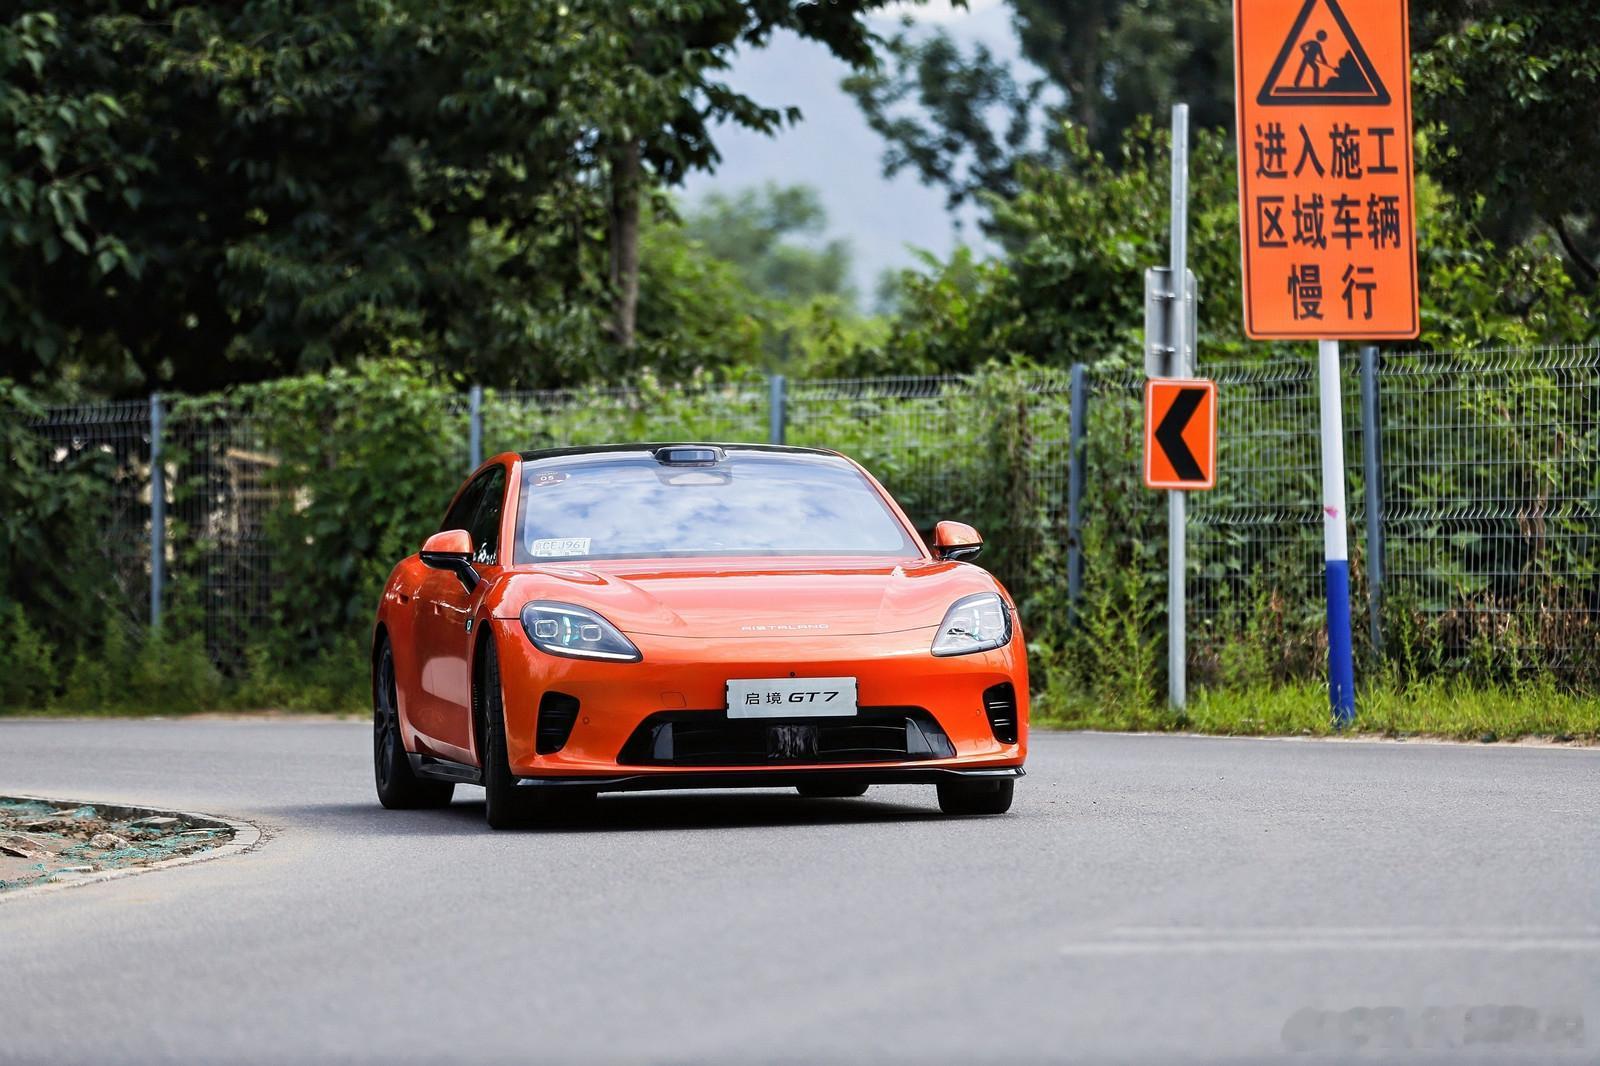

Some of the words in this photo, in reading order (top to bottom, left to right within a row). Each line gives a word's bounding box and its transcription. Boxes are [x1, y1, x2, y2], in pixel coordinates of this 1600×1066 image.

[1254, 122, 1399, 180] 进入施工
[1256, 193, 1401, 250] 区域车辆
[1287, 263, 1377, 321] 慢行
[745, 692, 782, 705] 启境
